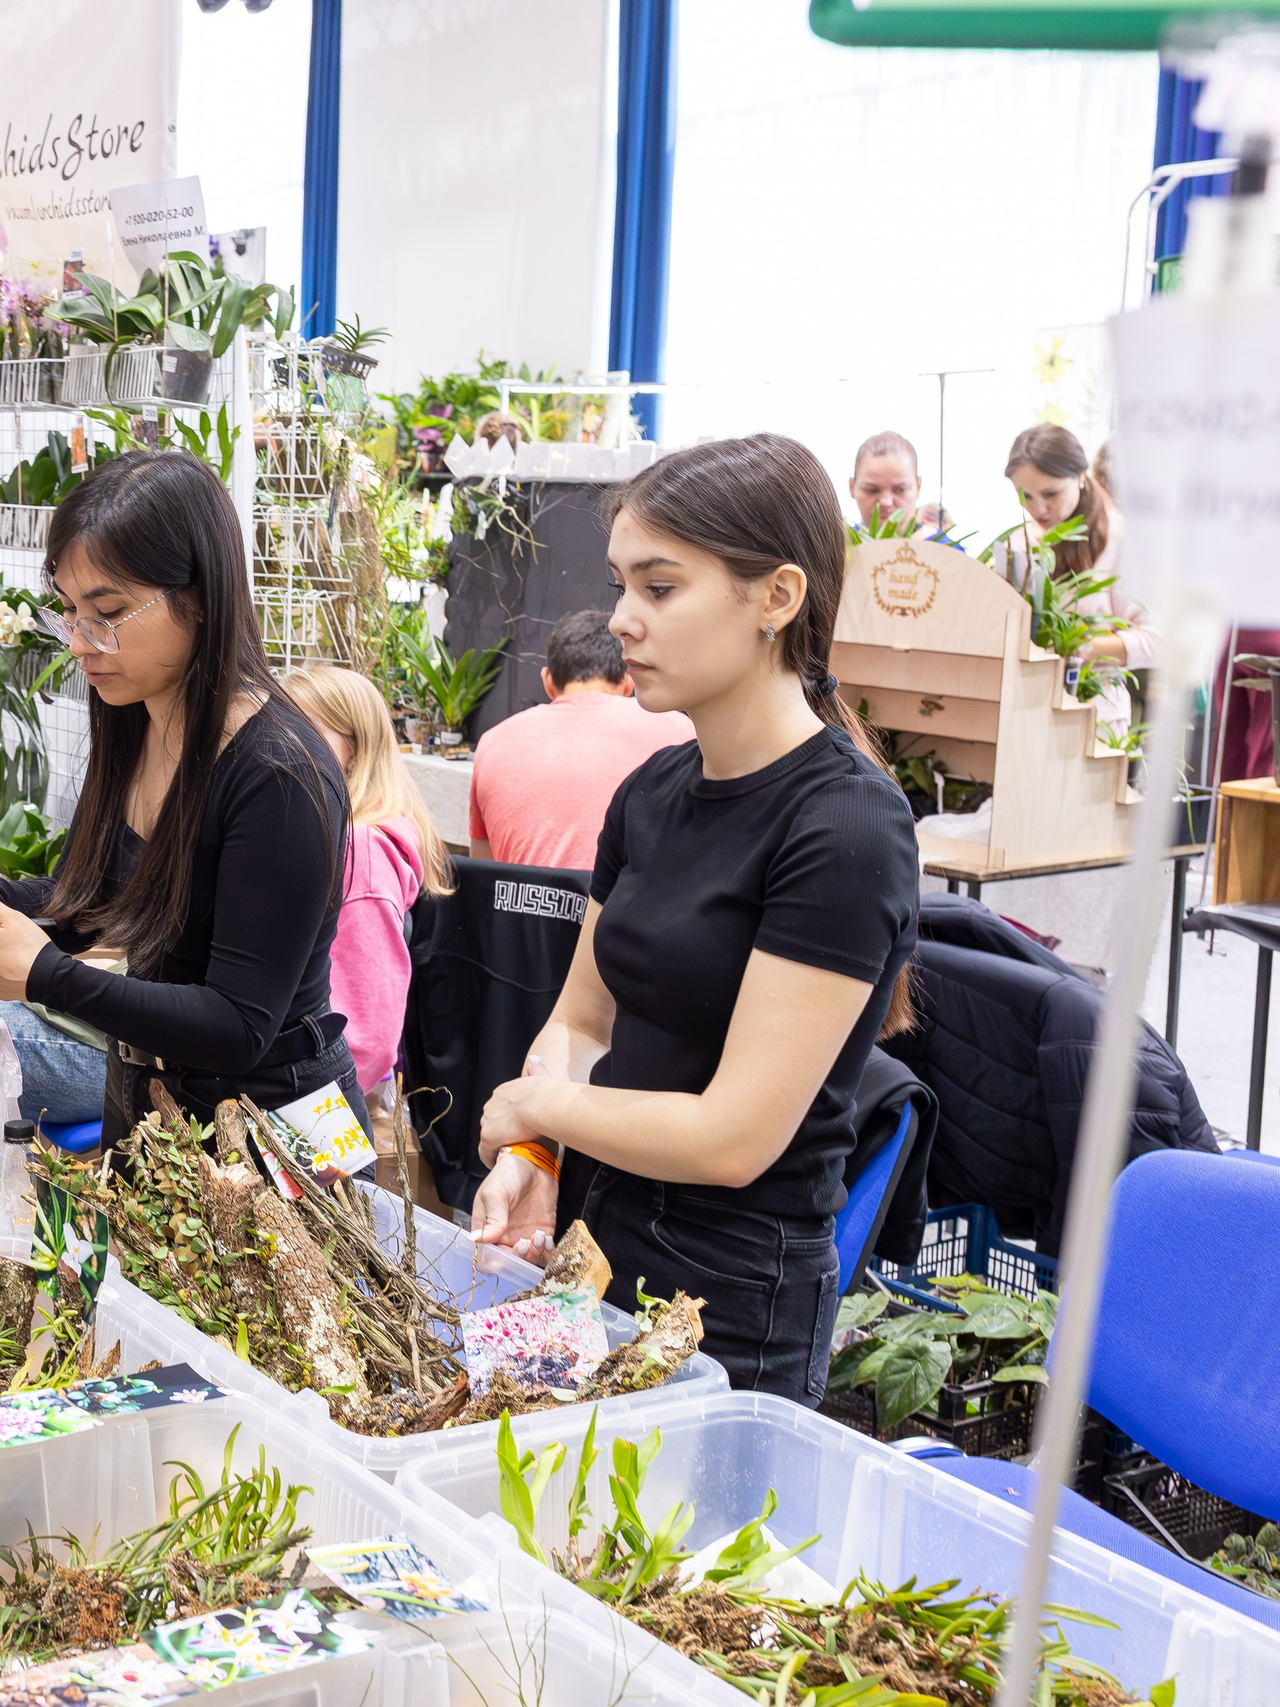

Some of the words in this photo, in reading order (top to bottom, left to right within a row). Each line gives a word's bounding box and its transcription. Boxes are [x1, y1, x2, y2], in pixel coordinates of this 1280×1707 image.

[889, 569, 920, 584] hand
[888, 586, 918, 600] made
[494, 880, 588, 925] RUSSIA
